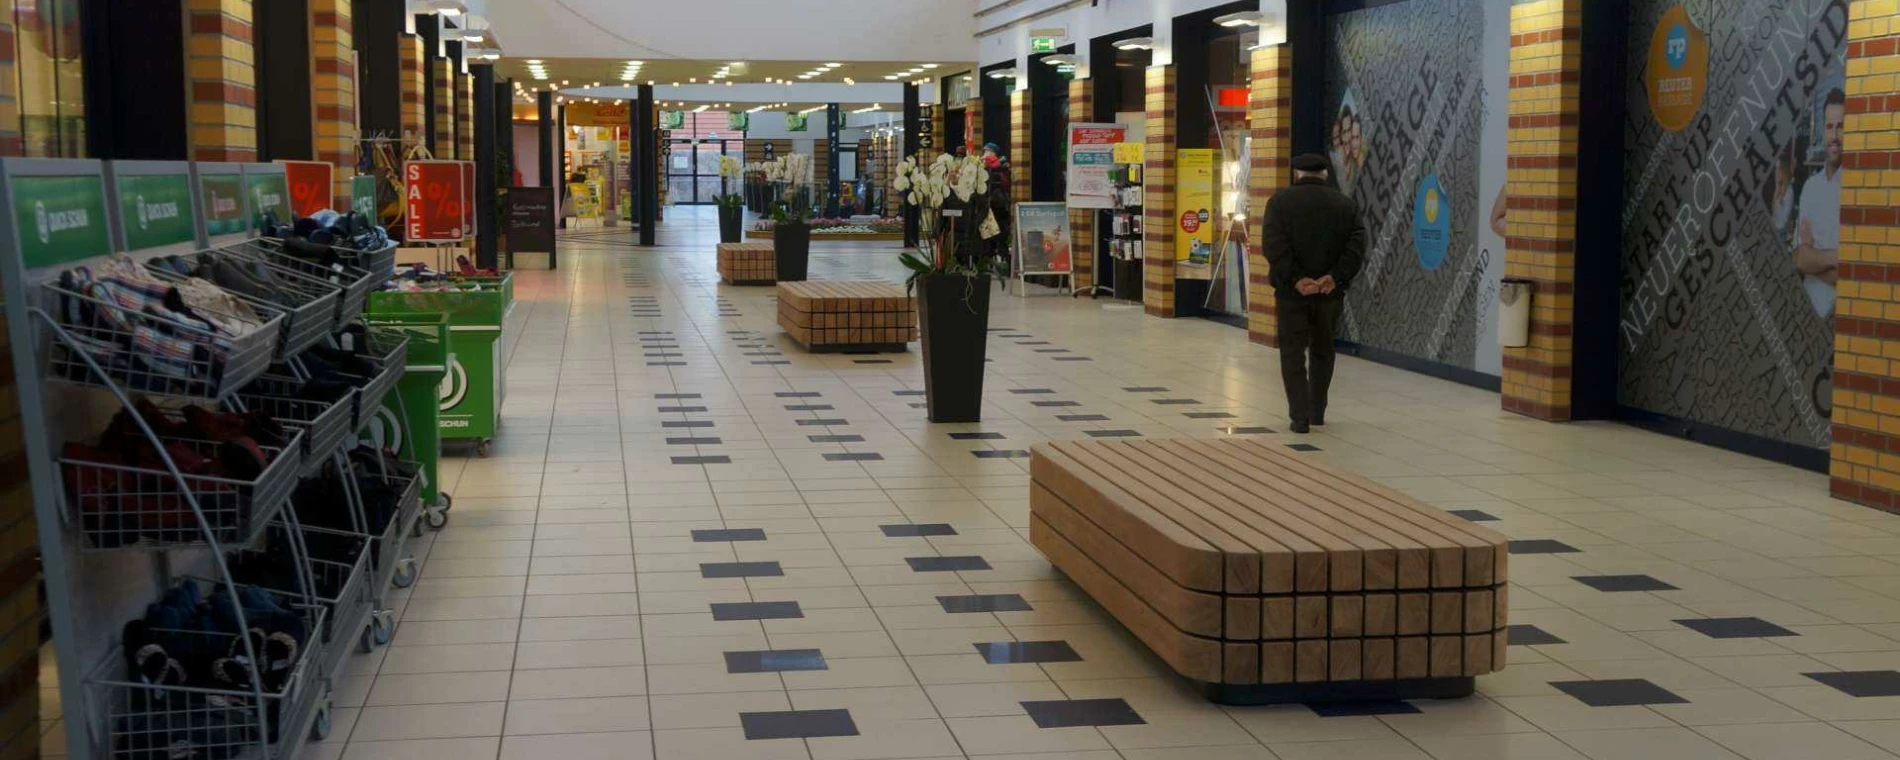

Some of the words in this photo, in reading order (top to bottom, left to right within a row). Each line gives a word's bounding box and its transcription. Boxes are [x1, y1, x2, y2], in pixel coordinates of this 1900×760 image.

[1658, 77, 1692, 92] REUTER
[409, 164, 421, 238] SALE
[1351, 99, 1399, 216] UTER
[1362, 52, 1438, 262] ASSAGE
[1620, 112, 1713, 302] START-UP
